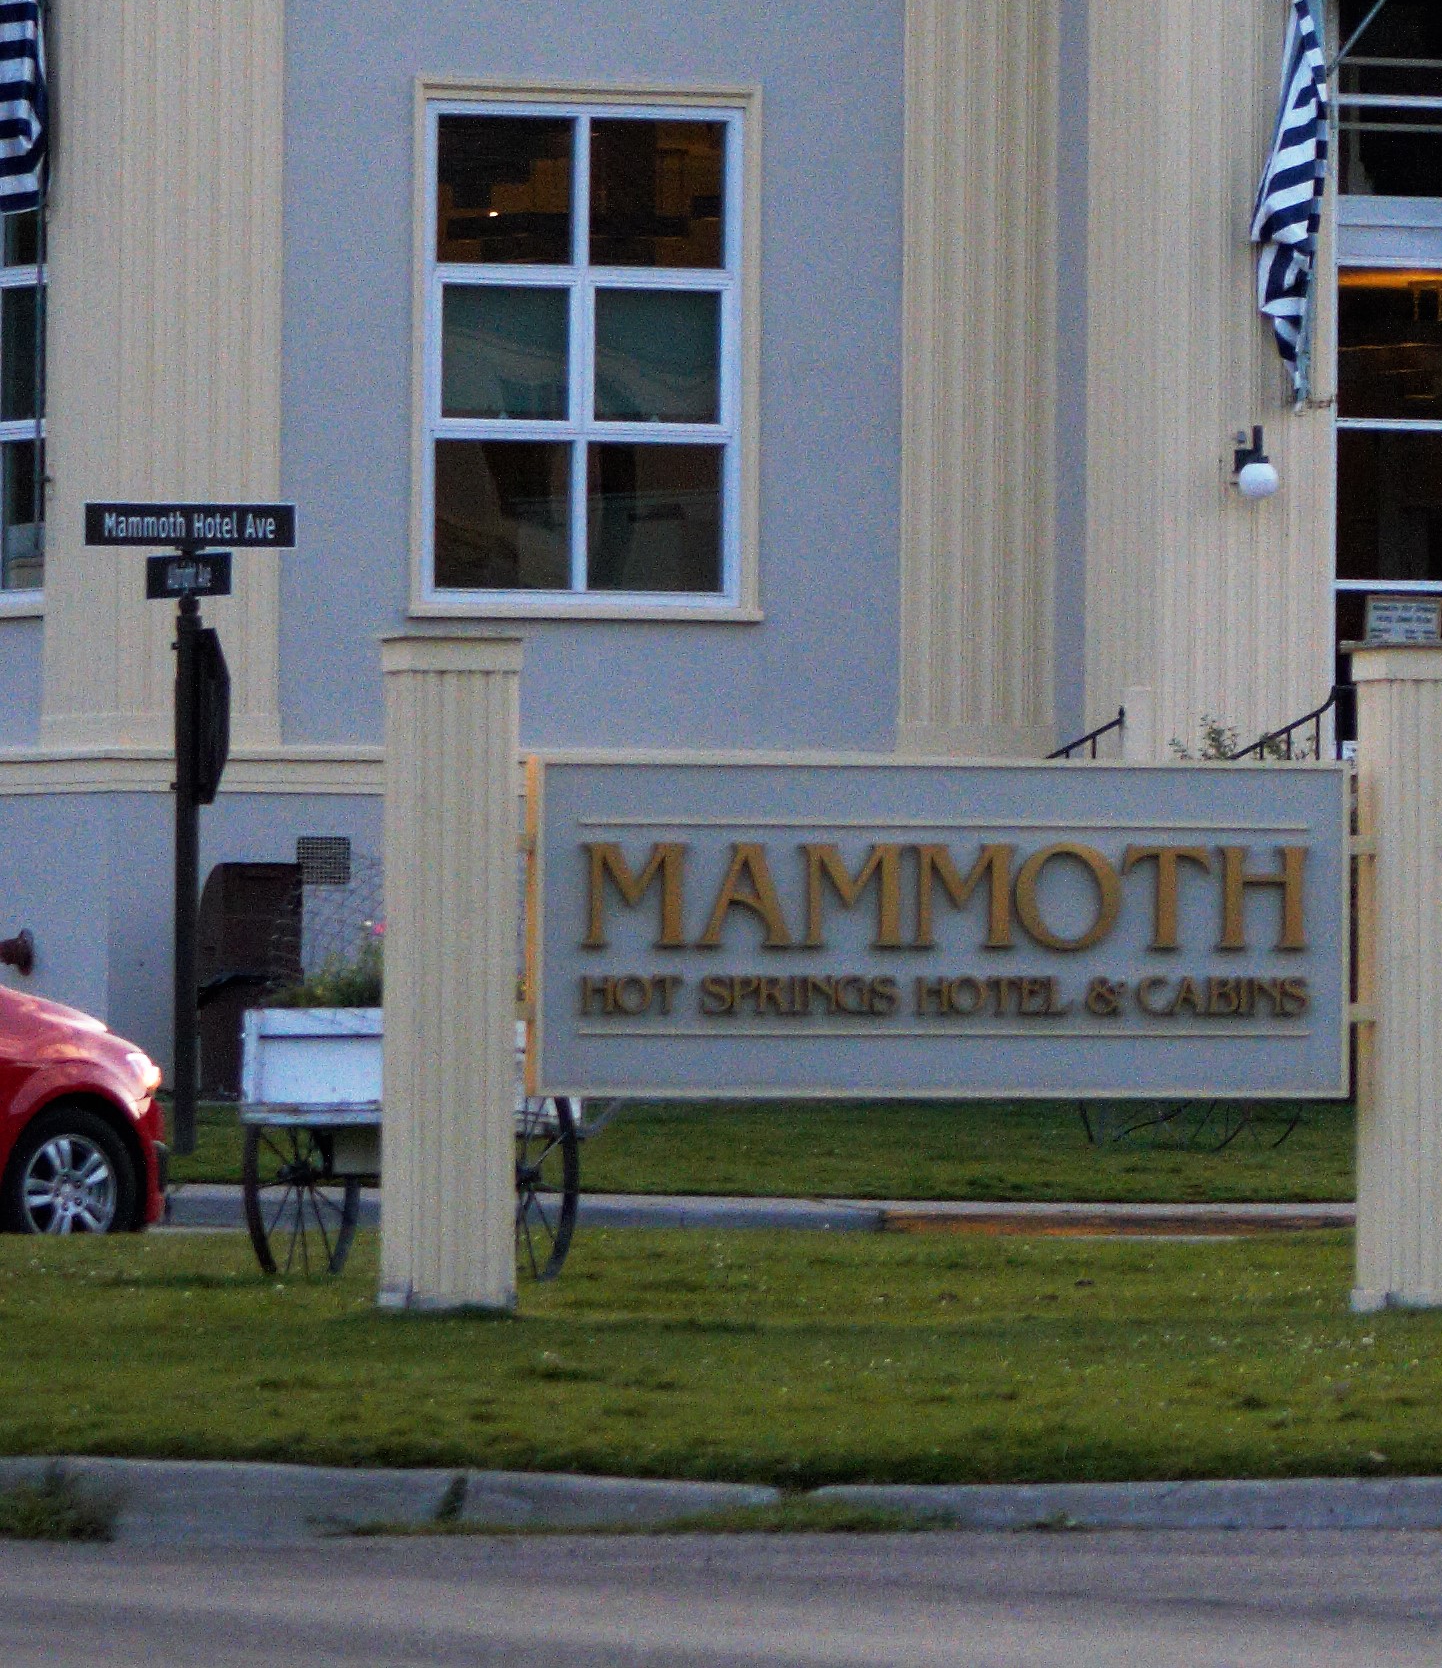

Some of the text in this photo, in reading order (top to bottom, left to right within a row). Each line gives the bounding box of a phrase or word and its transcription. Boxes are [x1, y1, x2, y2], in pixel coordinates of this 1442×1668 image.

[104, 511, 276, 539] Mammoth Hotel Ave
[580, 842, 1309, 952] MAMMOTH
[581, 975, 1310, 1018] HOT SPRINGS HOTEL & CABINS
